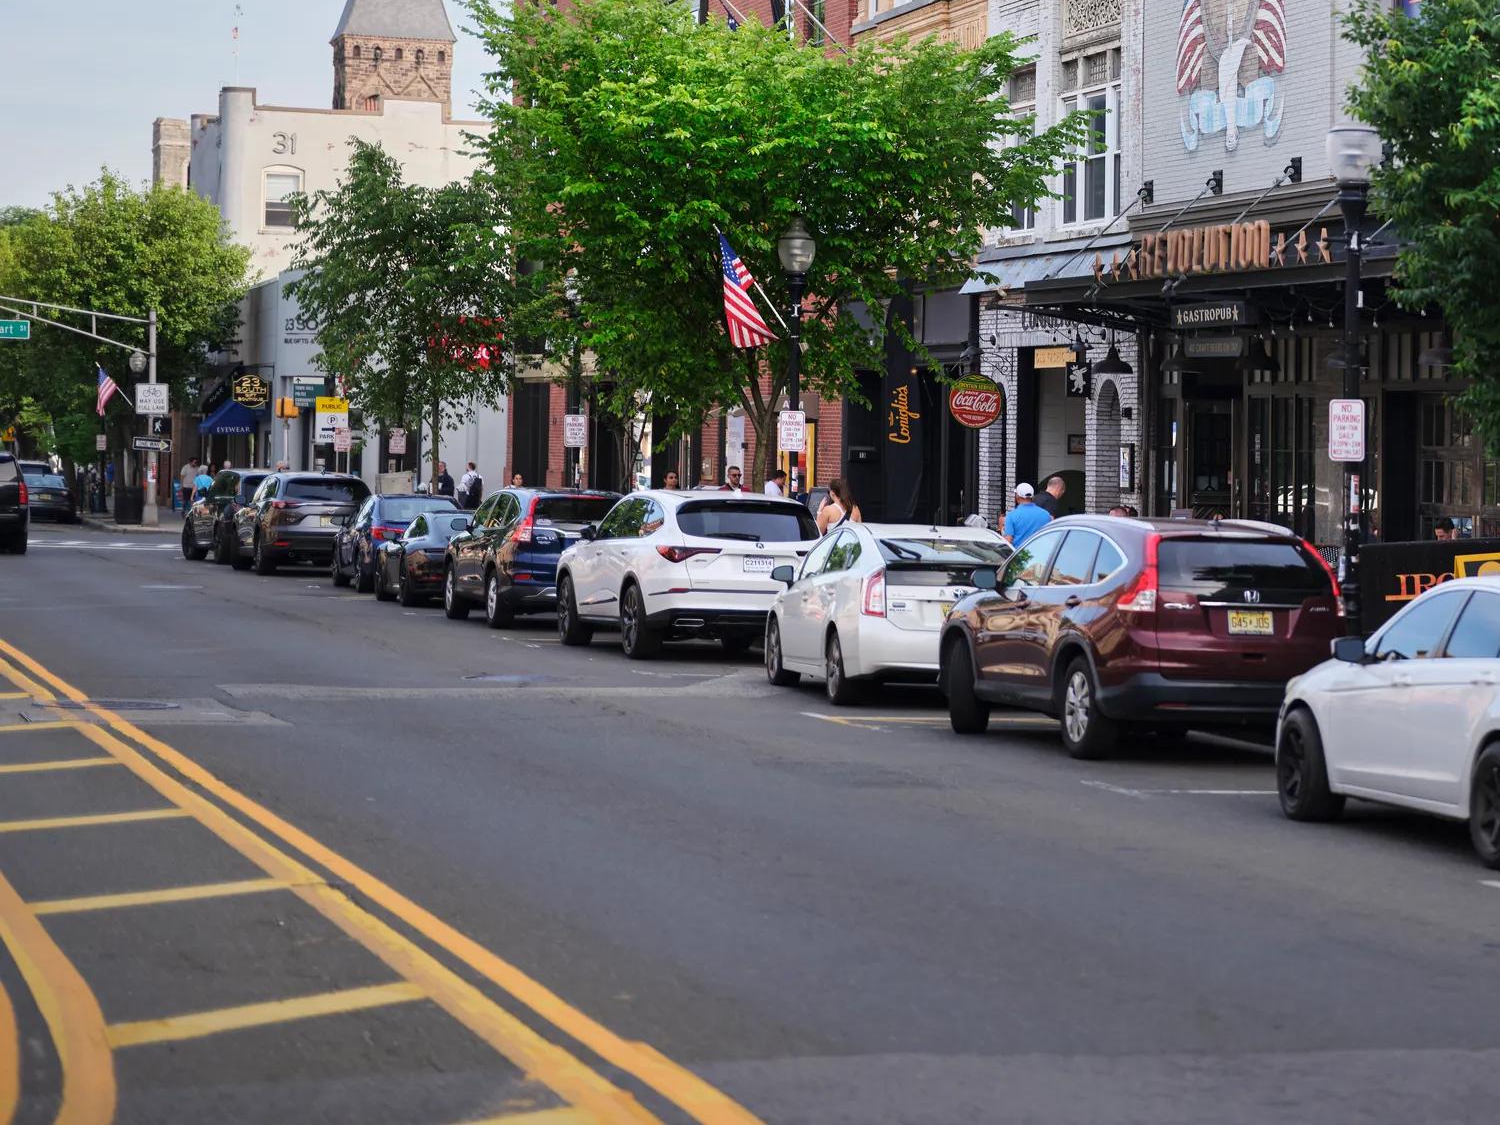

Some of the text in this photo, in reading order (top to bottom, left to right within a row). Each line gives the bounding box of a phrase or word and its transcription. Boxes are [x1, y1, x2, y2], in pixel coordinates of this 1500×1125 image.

[272, 131, 297, 155] 31
[1139, 219, 1271, 278] REVOLUTION
[1183, 307, 1232, 323] GASTROPUB
[242, 377, 260, 387] 23
[235, 386, 267, 394] SOUTH
[952, 392, 998, 413] Coca-Cola
[1341, 404, 1353, 413] NO
[889, 385, 921, 444] Coniglio's
[1333, 415, 1361, 424] PARKING
[1338, 432, 1354, 440] DAILY
